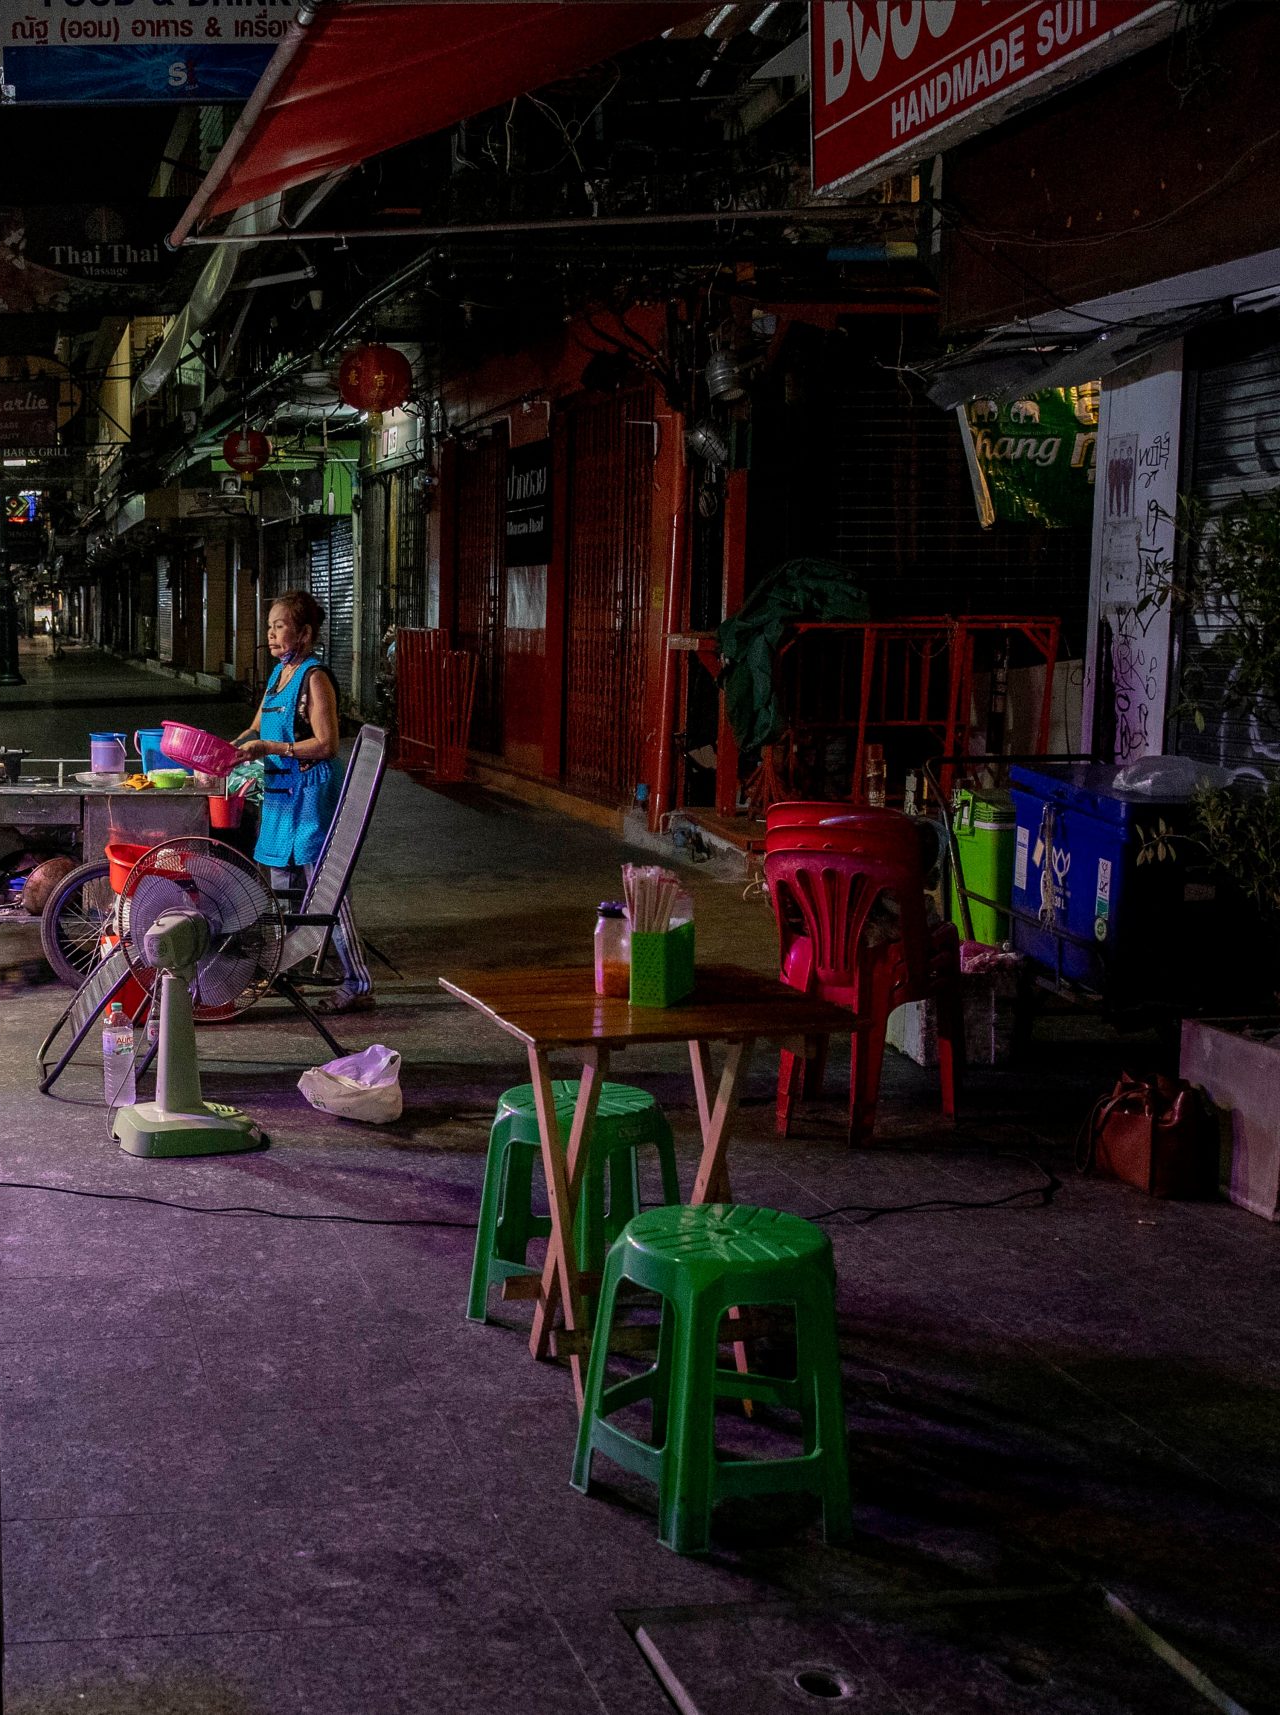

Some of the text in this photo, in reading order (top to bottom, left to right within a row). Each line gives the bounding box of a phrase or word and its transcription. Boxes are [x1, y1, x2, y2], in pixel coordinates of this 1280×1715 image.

[60, 17, 120, 42] (ออม)
[131, 19, 193, 37] อาหาร
[204, 16, 222, 37] &
[891, 25, 1025, 140] HANDMADE
[49, 243, 160, 265] Thai Thai
[82, 265, 129, 279] Massage
[4, 448, 26, 457] BAR
[28, 448, 38, 457] &
[38, 447, 71, 457] GRILL
[969, 426, 1062, 468] hang
